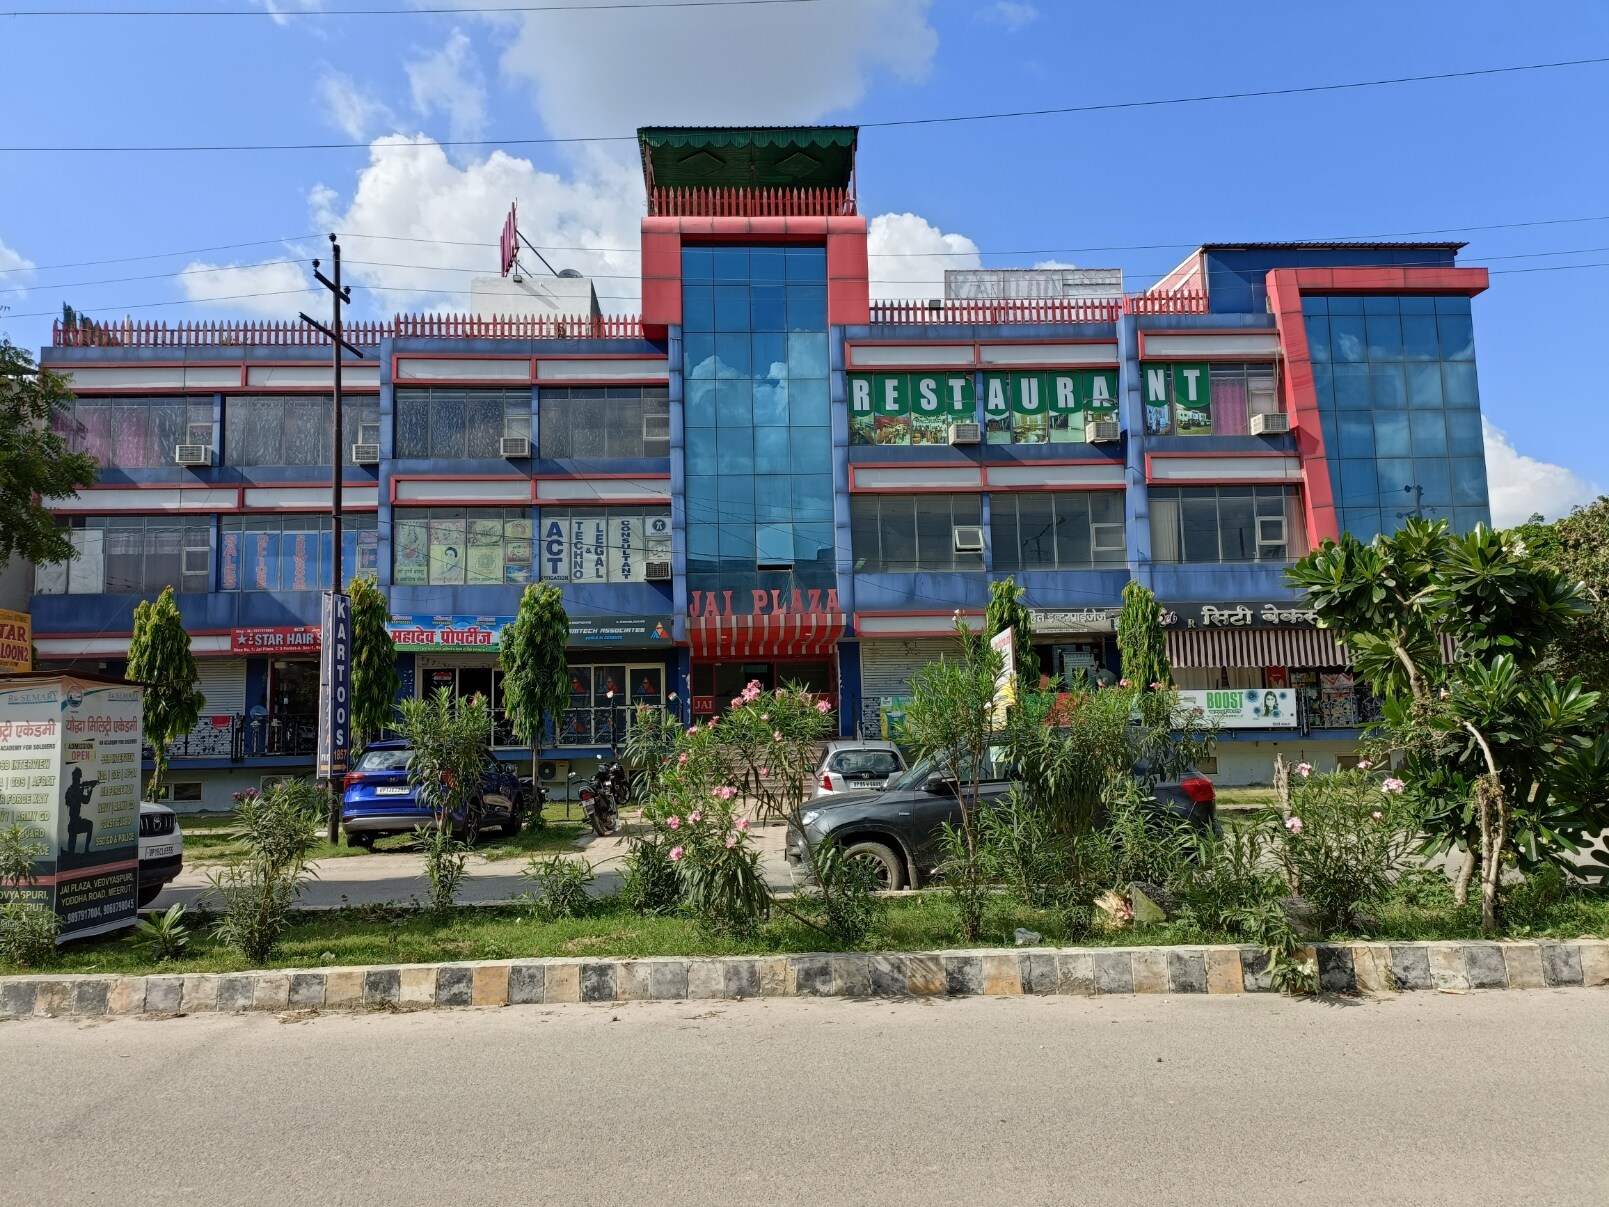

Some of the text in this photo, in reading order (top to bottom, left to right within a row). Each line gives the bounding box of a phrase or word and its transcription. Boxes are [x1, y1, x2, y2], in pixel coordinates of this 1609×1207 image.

[852, 369, 1200, 411] RESTAURANT
[546, 522, 564, 574] ACT
[573, 522, 584, 579] TECHNO
[595, 523, 604, 578] LEGAL
[621, 520, 631, 579] CONSULTANT
[689, 589, 842, 617] JAI PLAZA
[1201, 605, 1253, 626] सिटी
[255, 633, 284, 645] STAR
[287, 632, 314, 644] HAIR
[390, 626, 436, 644] महादेव
[336, 601, 346, 746] KARTOOS
[695, 700, 713, 709] JAI
[1206, 692, 1243, 708] BOOST
[71, 750, 90, 761] OPEN
[333, 750, 347, 761] 1857
[0, 759, 50, 770] SB INTERVIEW
[10, 777, 26, 787] CDS
[7, 794, 32, 804] FORCE
[16, 811, 38, 821] ARMY
[60, 883, 70, 895] JAI
[70, 880, 92, 893] PLAZA,
[61, 894, 88, 906] YODDHA
